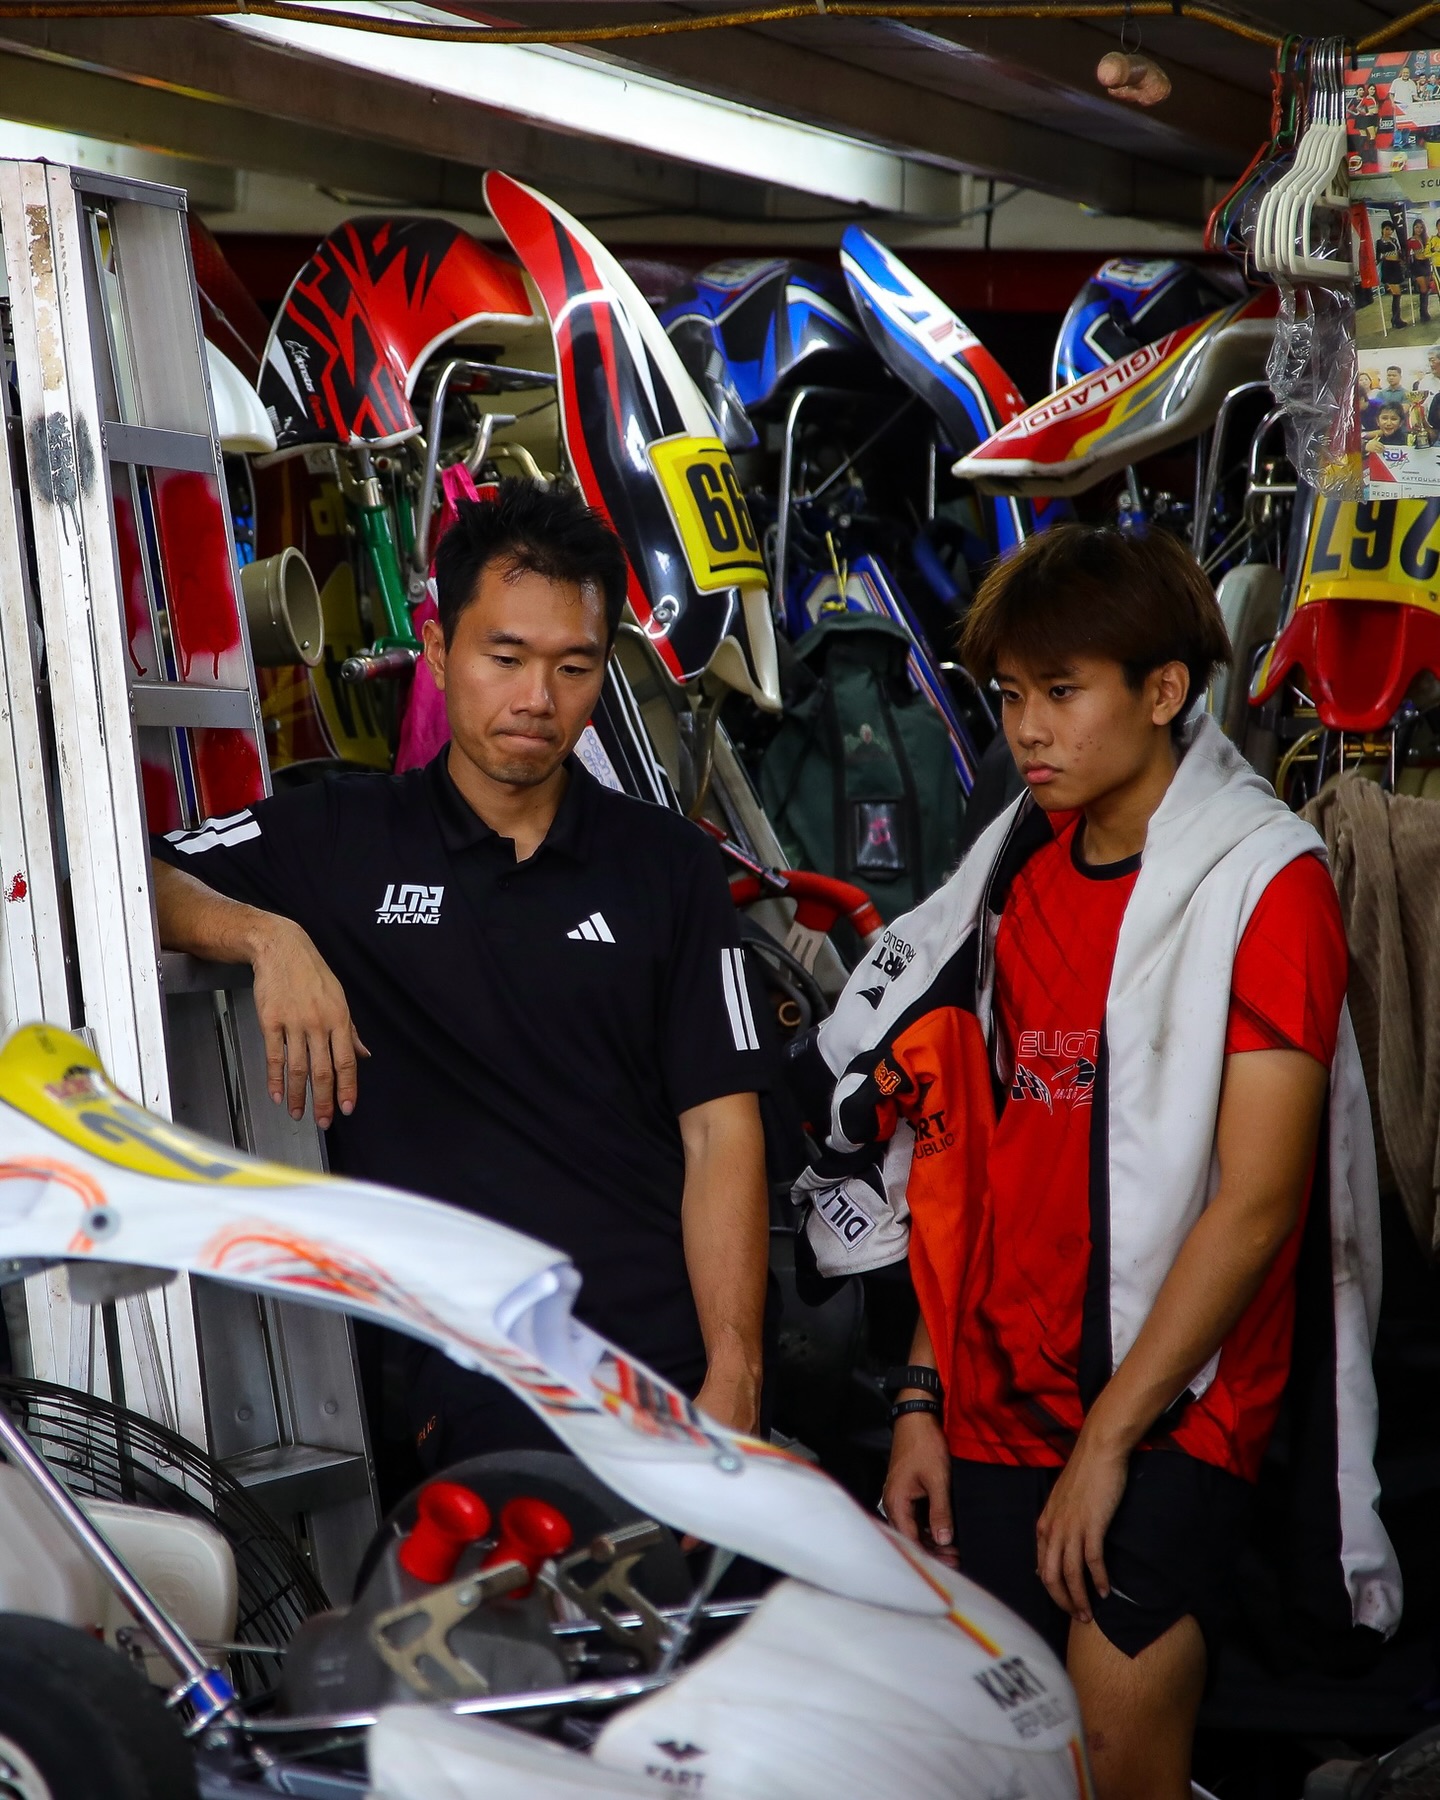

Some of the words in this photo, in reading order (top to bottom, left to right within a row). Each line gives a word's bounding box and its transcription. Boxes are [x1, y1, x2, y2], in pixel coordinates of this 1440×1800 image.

[1030, 345, 1150, 428] GILLARD
[1311, 498, 1440, 580] 267
[376, 913, 442, 925] RACING
[974, 1656, 1048, 1712] KART
